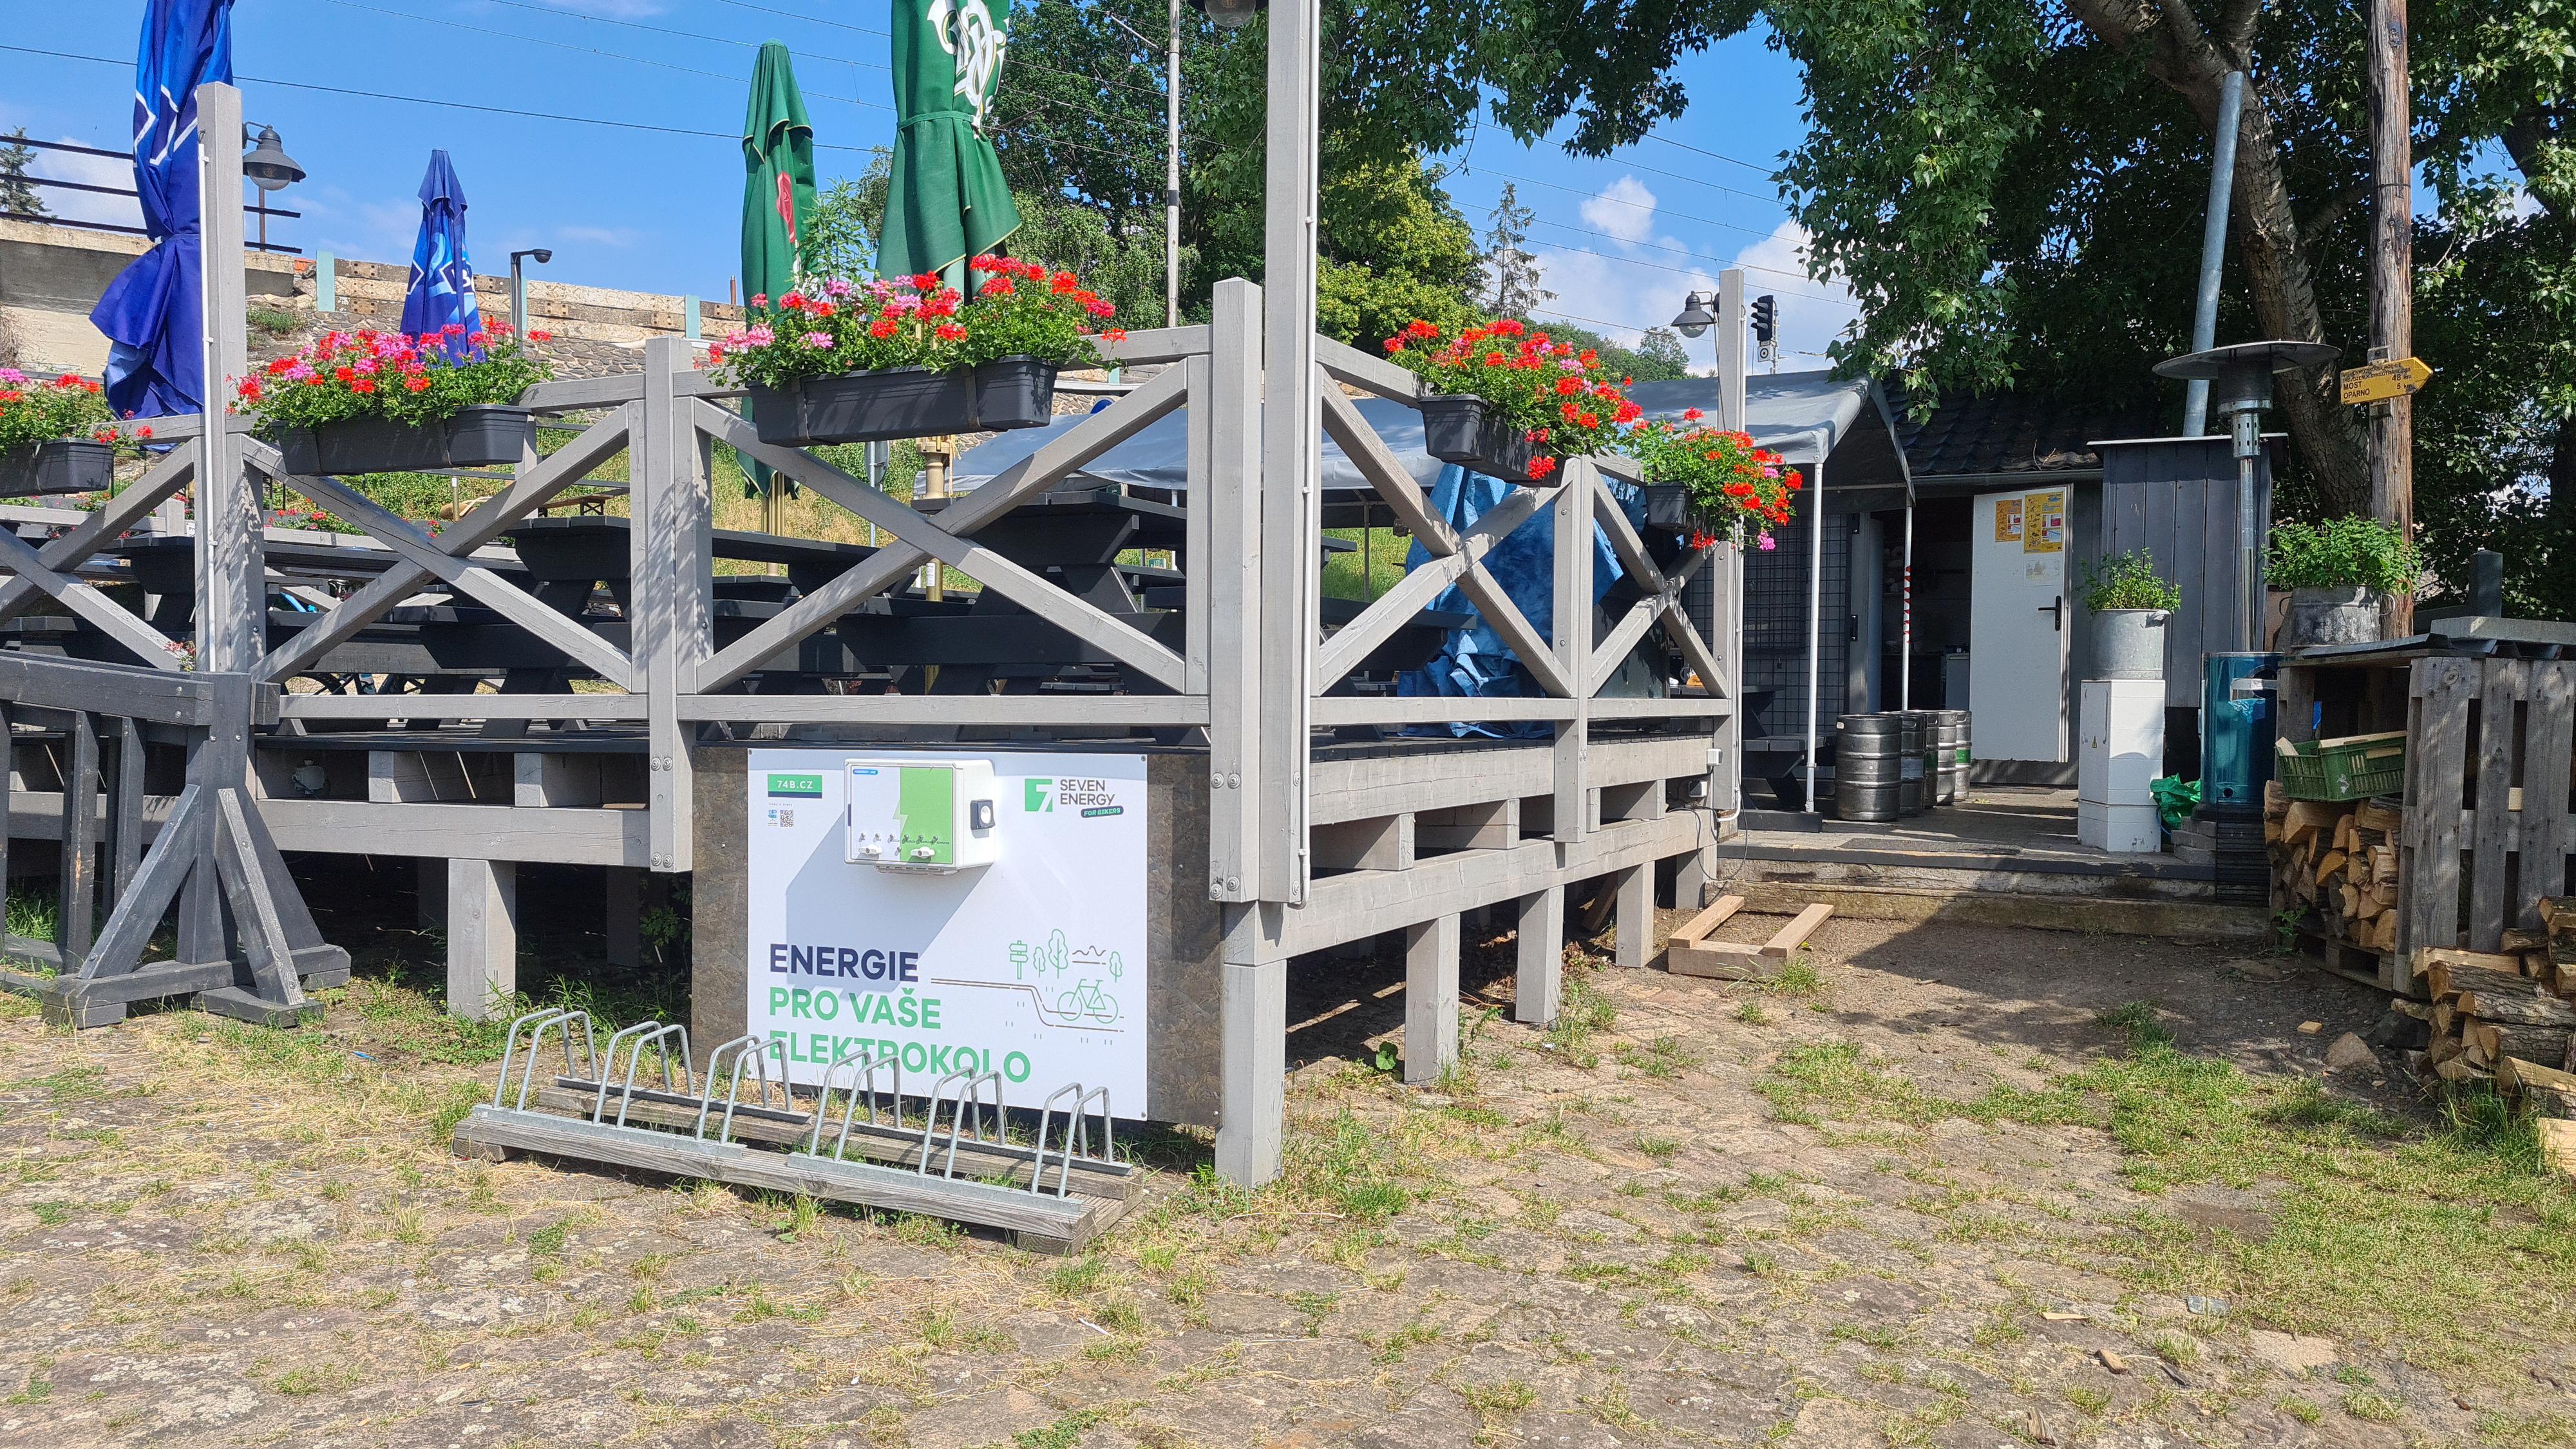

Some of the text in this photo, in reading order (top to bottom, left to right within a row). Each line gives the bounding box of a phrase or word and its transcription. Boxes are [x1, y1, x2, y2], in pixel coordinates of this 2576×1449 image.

[2343, 381, 2362, 390] MOST
[2344, 388, 2370, 399] OPÁRNO
[777, 780, 813, 790] 74B.CZ
[1060, 793, 1115, 806] ENERGY
[1097, 808, 1121, 816] BIKERS
[770, 943, 919, 983] ENERGIE
[770, 987, 942, 1030] PRO VAŠE
[769, 1030, 1031, 1083] ELEKTROKOLO
